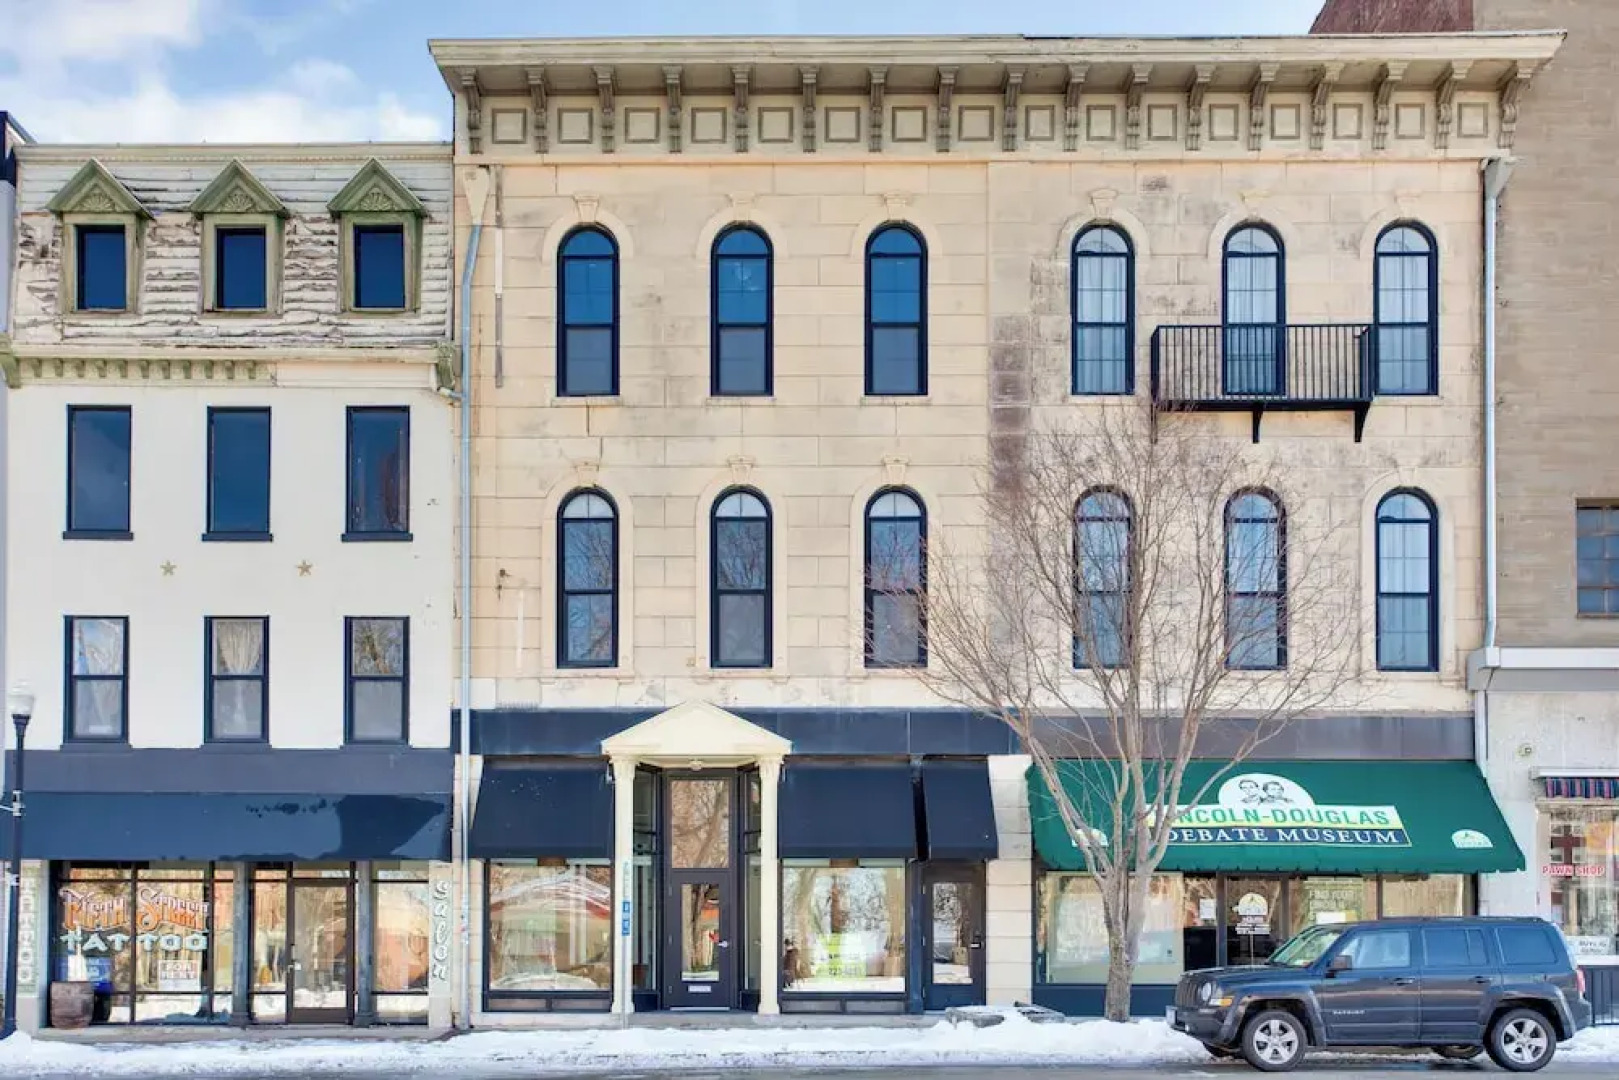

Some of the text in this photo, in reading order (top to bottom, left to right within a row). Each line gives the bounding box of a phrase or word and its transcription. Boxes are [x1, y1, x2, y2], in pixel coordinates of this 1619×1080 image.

[1157, 808, 1390, 825] NCOLN-DOUGLAS
[1276, 828, 1400, 843] MUSEUM
[1542, 866, 1604, 875] PAWN SHOP
[60, 932, 208, 952] TATTOO
